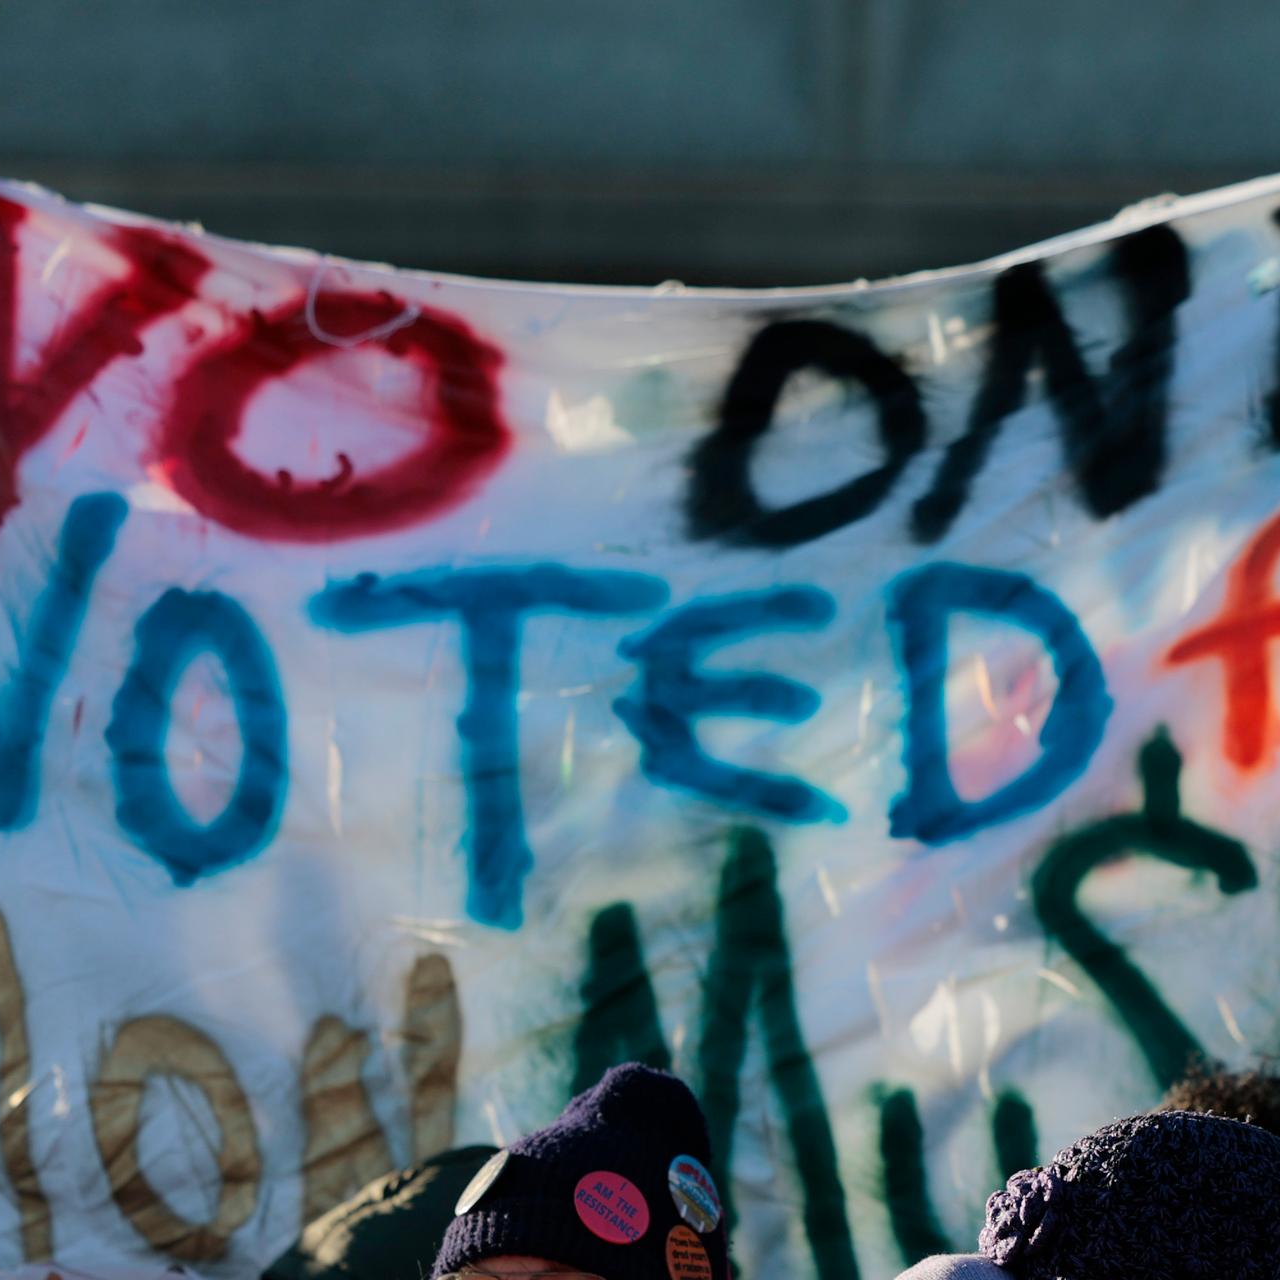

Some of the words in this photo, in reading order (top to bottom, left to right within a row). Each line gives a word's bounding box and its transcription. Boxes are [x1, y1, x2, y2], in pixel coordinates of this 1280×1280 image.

[576, 1188, 641, 1243] RESISTANCE
[593, 1182, 614, 1201] AM
[616, 1197, 638, 1219] THE
